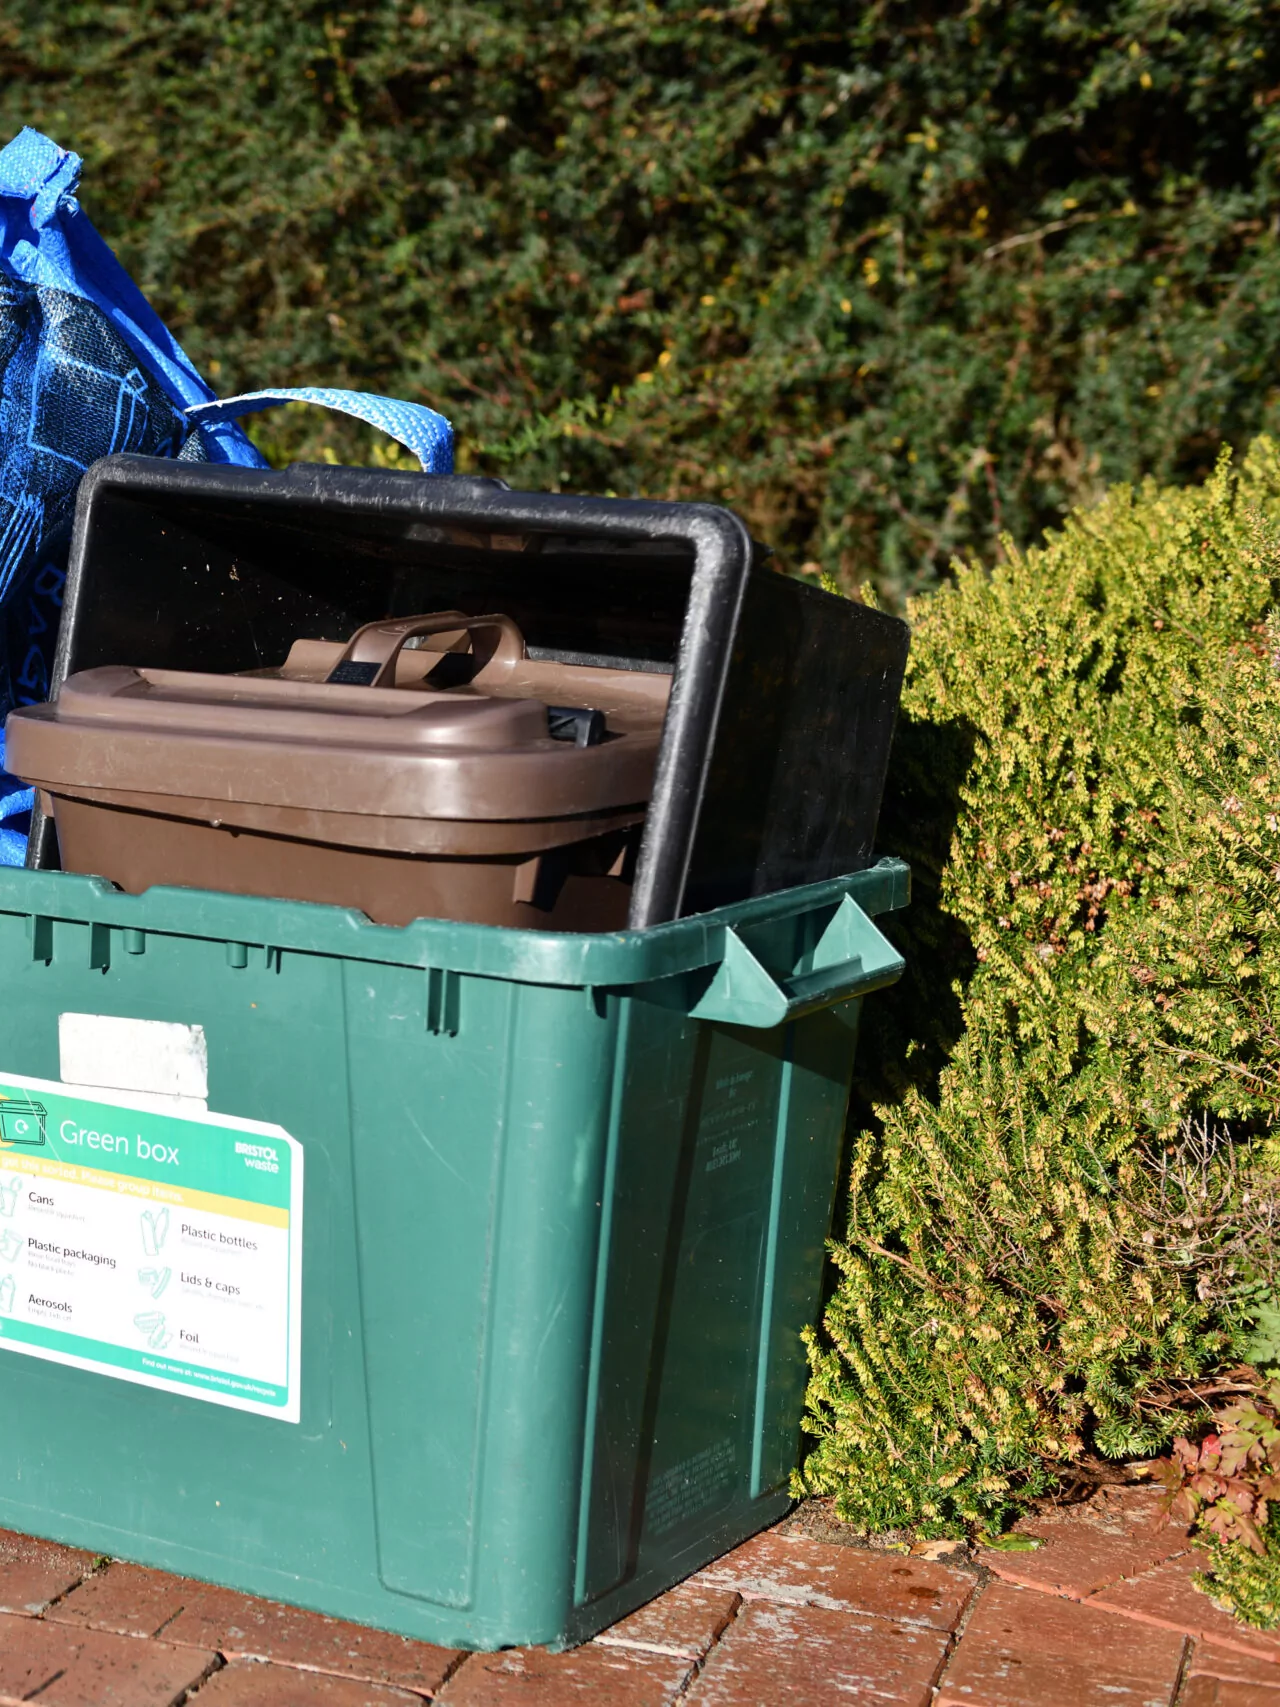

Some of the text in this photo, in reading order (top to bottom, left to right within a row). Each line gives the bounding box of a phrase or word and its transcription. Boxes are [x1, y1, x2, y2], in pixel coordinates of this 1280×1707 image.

[60, 1119, 179, 1165] Green box
[235, 1142, 279, 1161] BRISTOL
[1, 1156, 20, 1169] get
[21, 1158, 39, 1172] this
[81, 1169, 116, 1188] Please
[118, 1181, 151, 1195] group
[244, 1157, 279, 1174] waste
[28, 1191, 55, 1206] Cans
[181, 1223, 217, 1241] Plastic
[219, 1232, 259, 1251] bottles
[28, 1237, 61, 1255] Plastic
[63, 1247, 117, 1270] packaging
[181, 1271, 241, 1296] Lids & caps
[28, 1293, 73, 1313] Aerosols
[180, 1329, 199, 1343] Foil
[142, 1357, 155, 1368] Find
[156, 1361, 167, 1370] out
[168, 1365, 184, 1376] more
